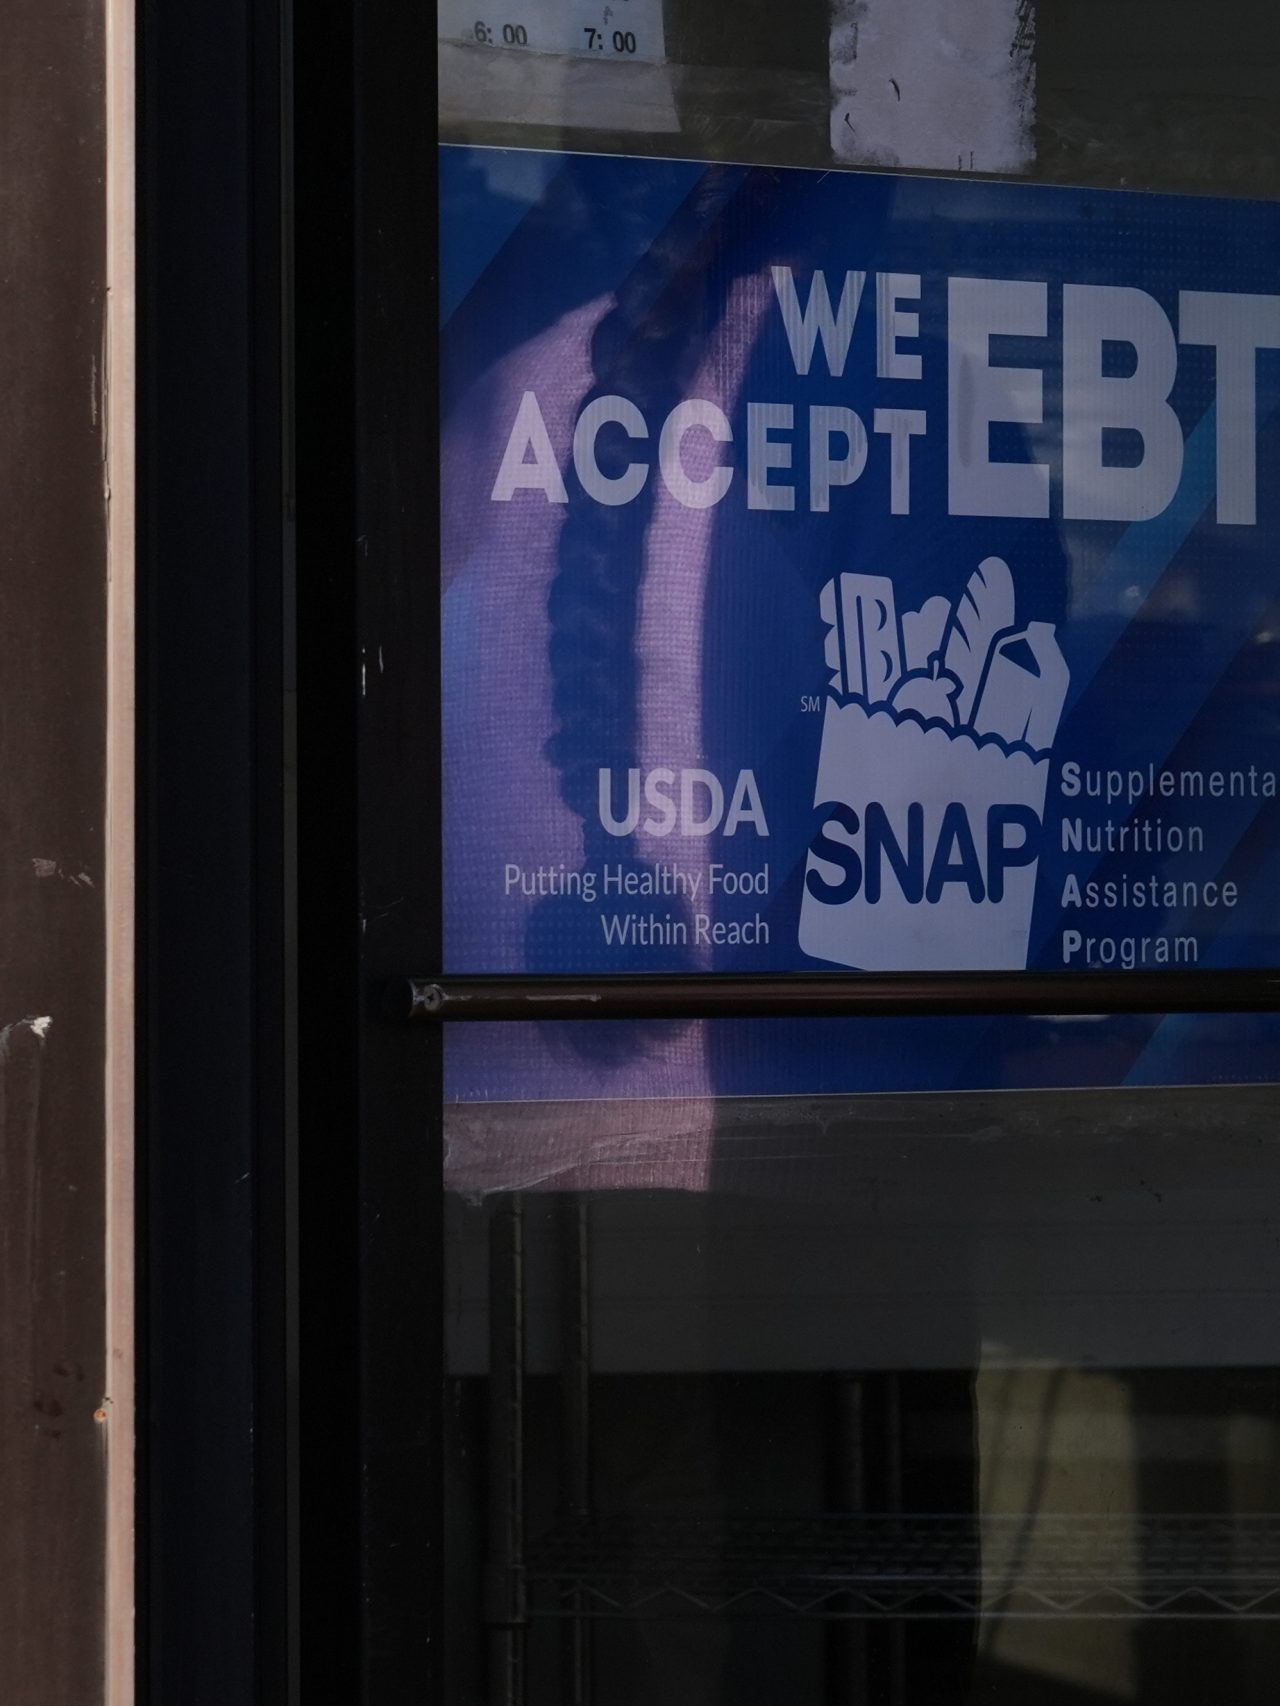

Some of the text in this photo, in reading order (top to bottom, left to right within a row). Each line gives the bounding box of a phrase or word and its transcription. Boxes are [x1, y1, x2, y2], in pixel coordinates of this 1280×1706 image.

[771, 266, 923, 379] WE
[491, 390, 927, 514] ACCEPT
[598, 768, 769, 837] USDA
[806, 801, 1043, 905] SNAP
[1061, 818, 1204, 852] Nutrition
[504, 863, 769, 903] Putting Healthy Food
[1062, 873, 1238, 908] Assistance
[601, 913, 770, 945] Within Reach
[1062, 929, 1199, 970] Program
